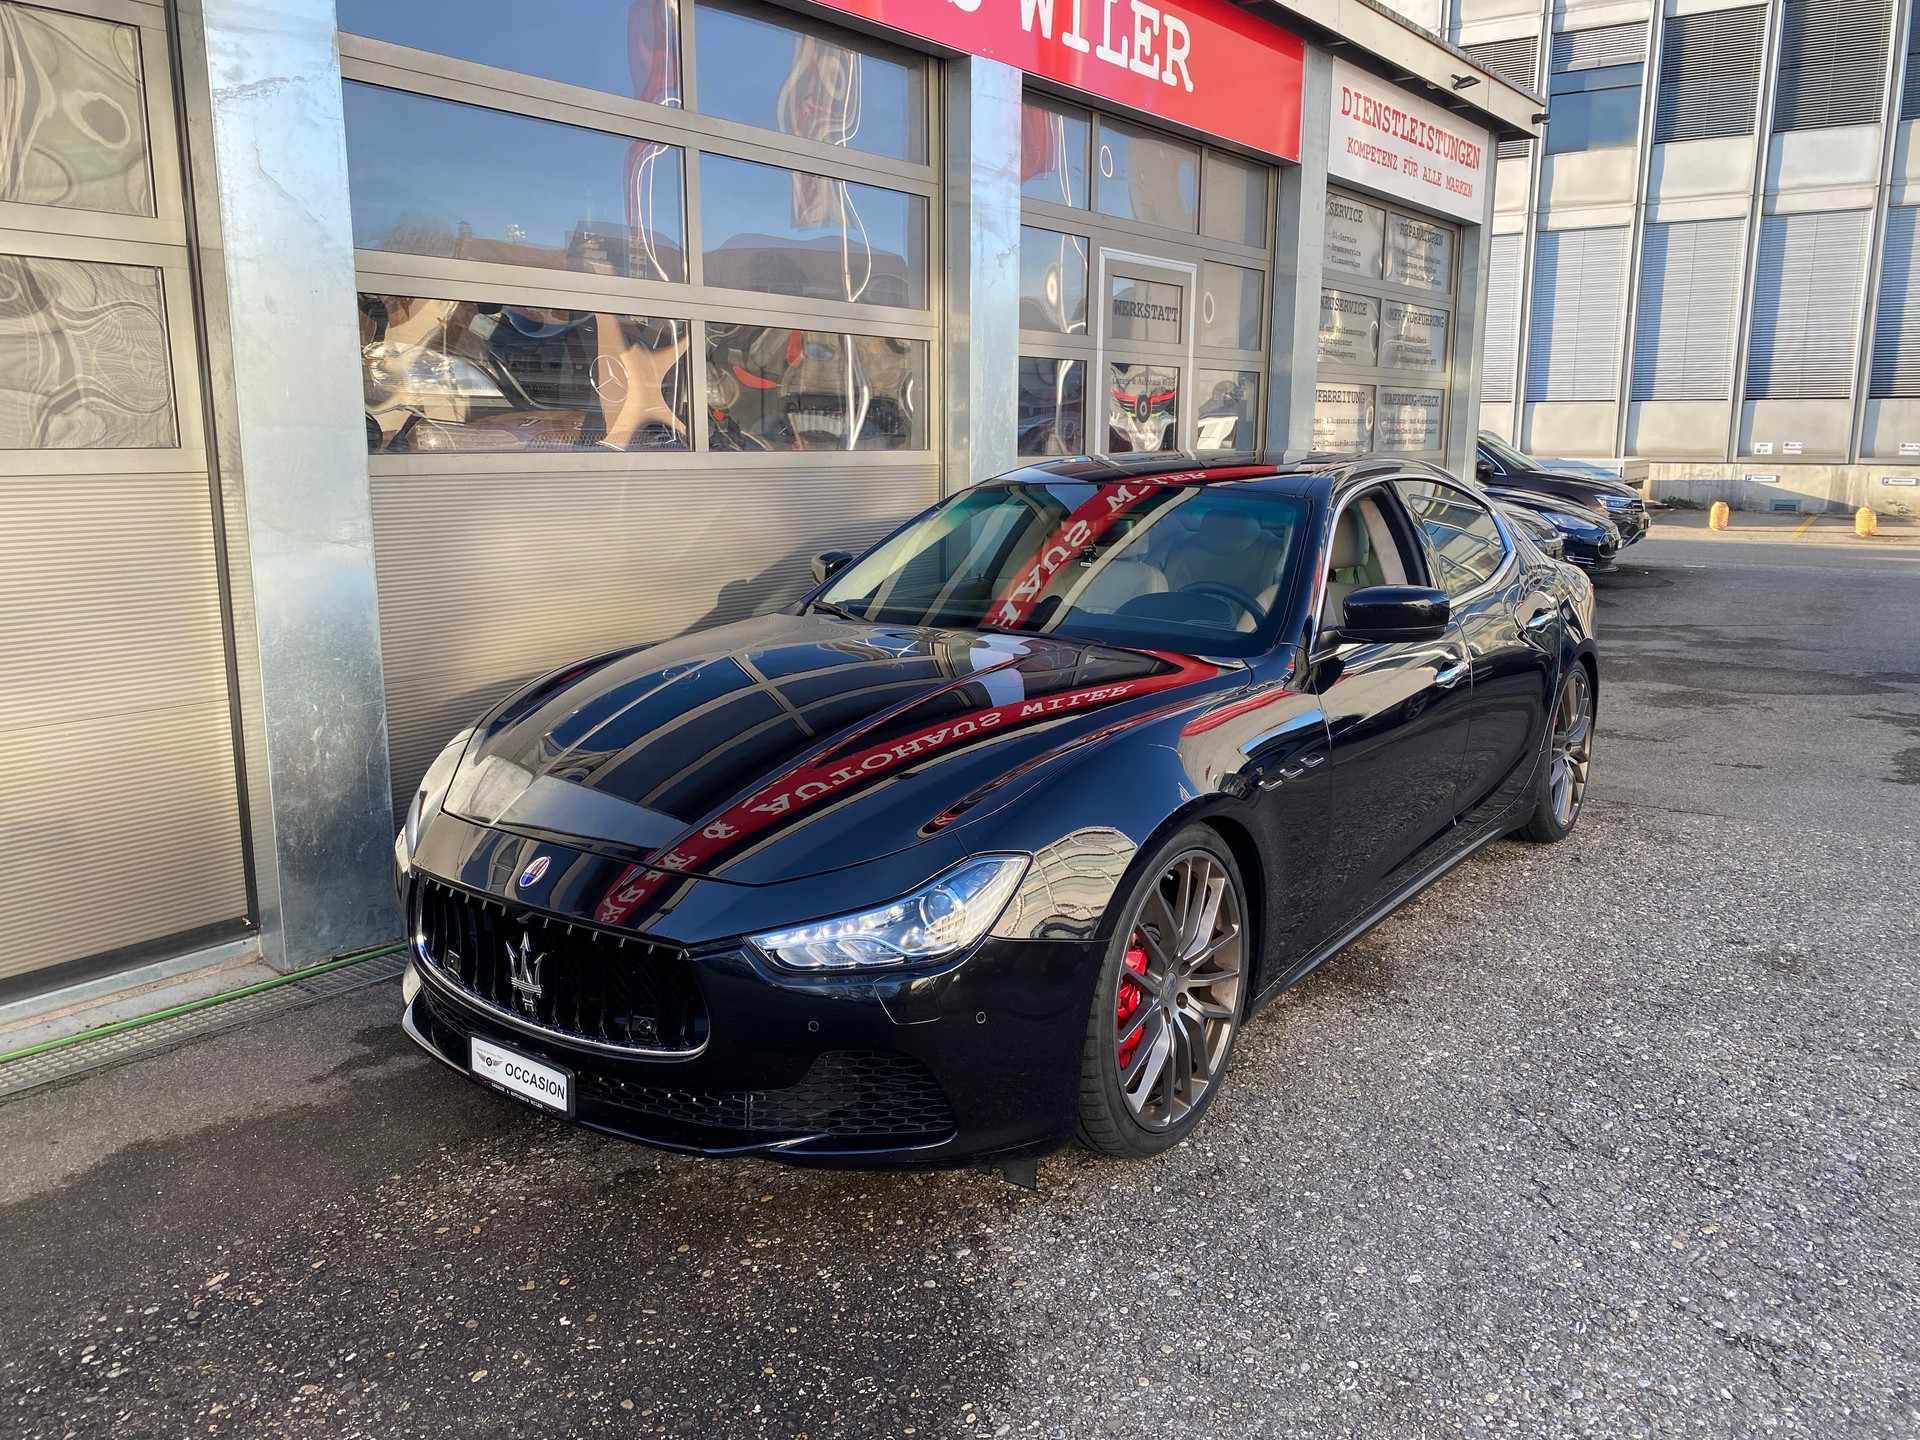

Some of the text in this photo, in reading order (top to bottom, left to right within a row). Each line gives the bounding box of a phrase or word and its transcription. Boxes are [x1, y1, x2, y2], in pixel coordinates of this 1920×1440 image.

[1017, 0, 1194, 93] WILER
[1341, 86, 1481, 171] DIENSTLEISTUNGEN
[1346, 136, 1473, 198] KOMPETENZ FÜR ALLE MARKEN
[1329, 201, 1364, 223] SERVICE
[1113, 299, 1178, 322] WERKSTATT
[1320, 295, 1368, 316] NEUSERVICE
[1315, 389, 1366, 404] FBEREITUNG
[504, 1062, 566, 1101] OCCASION
